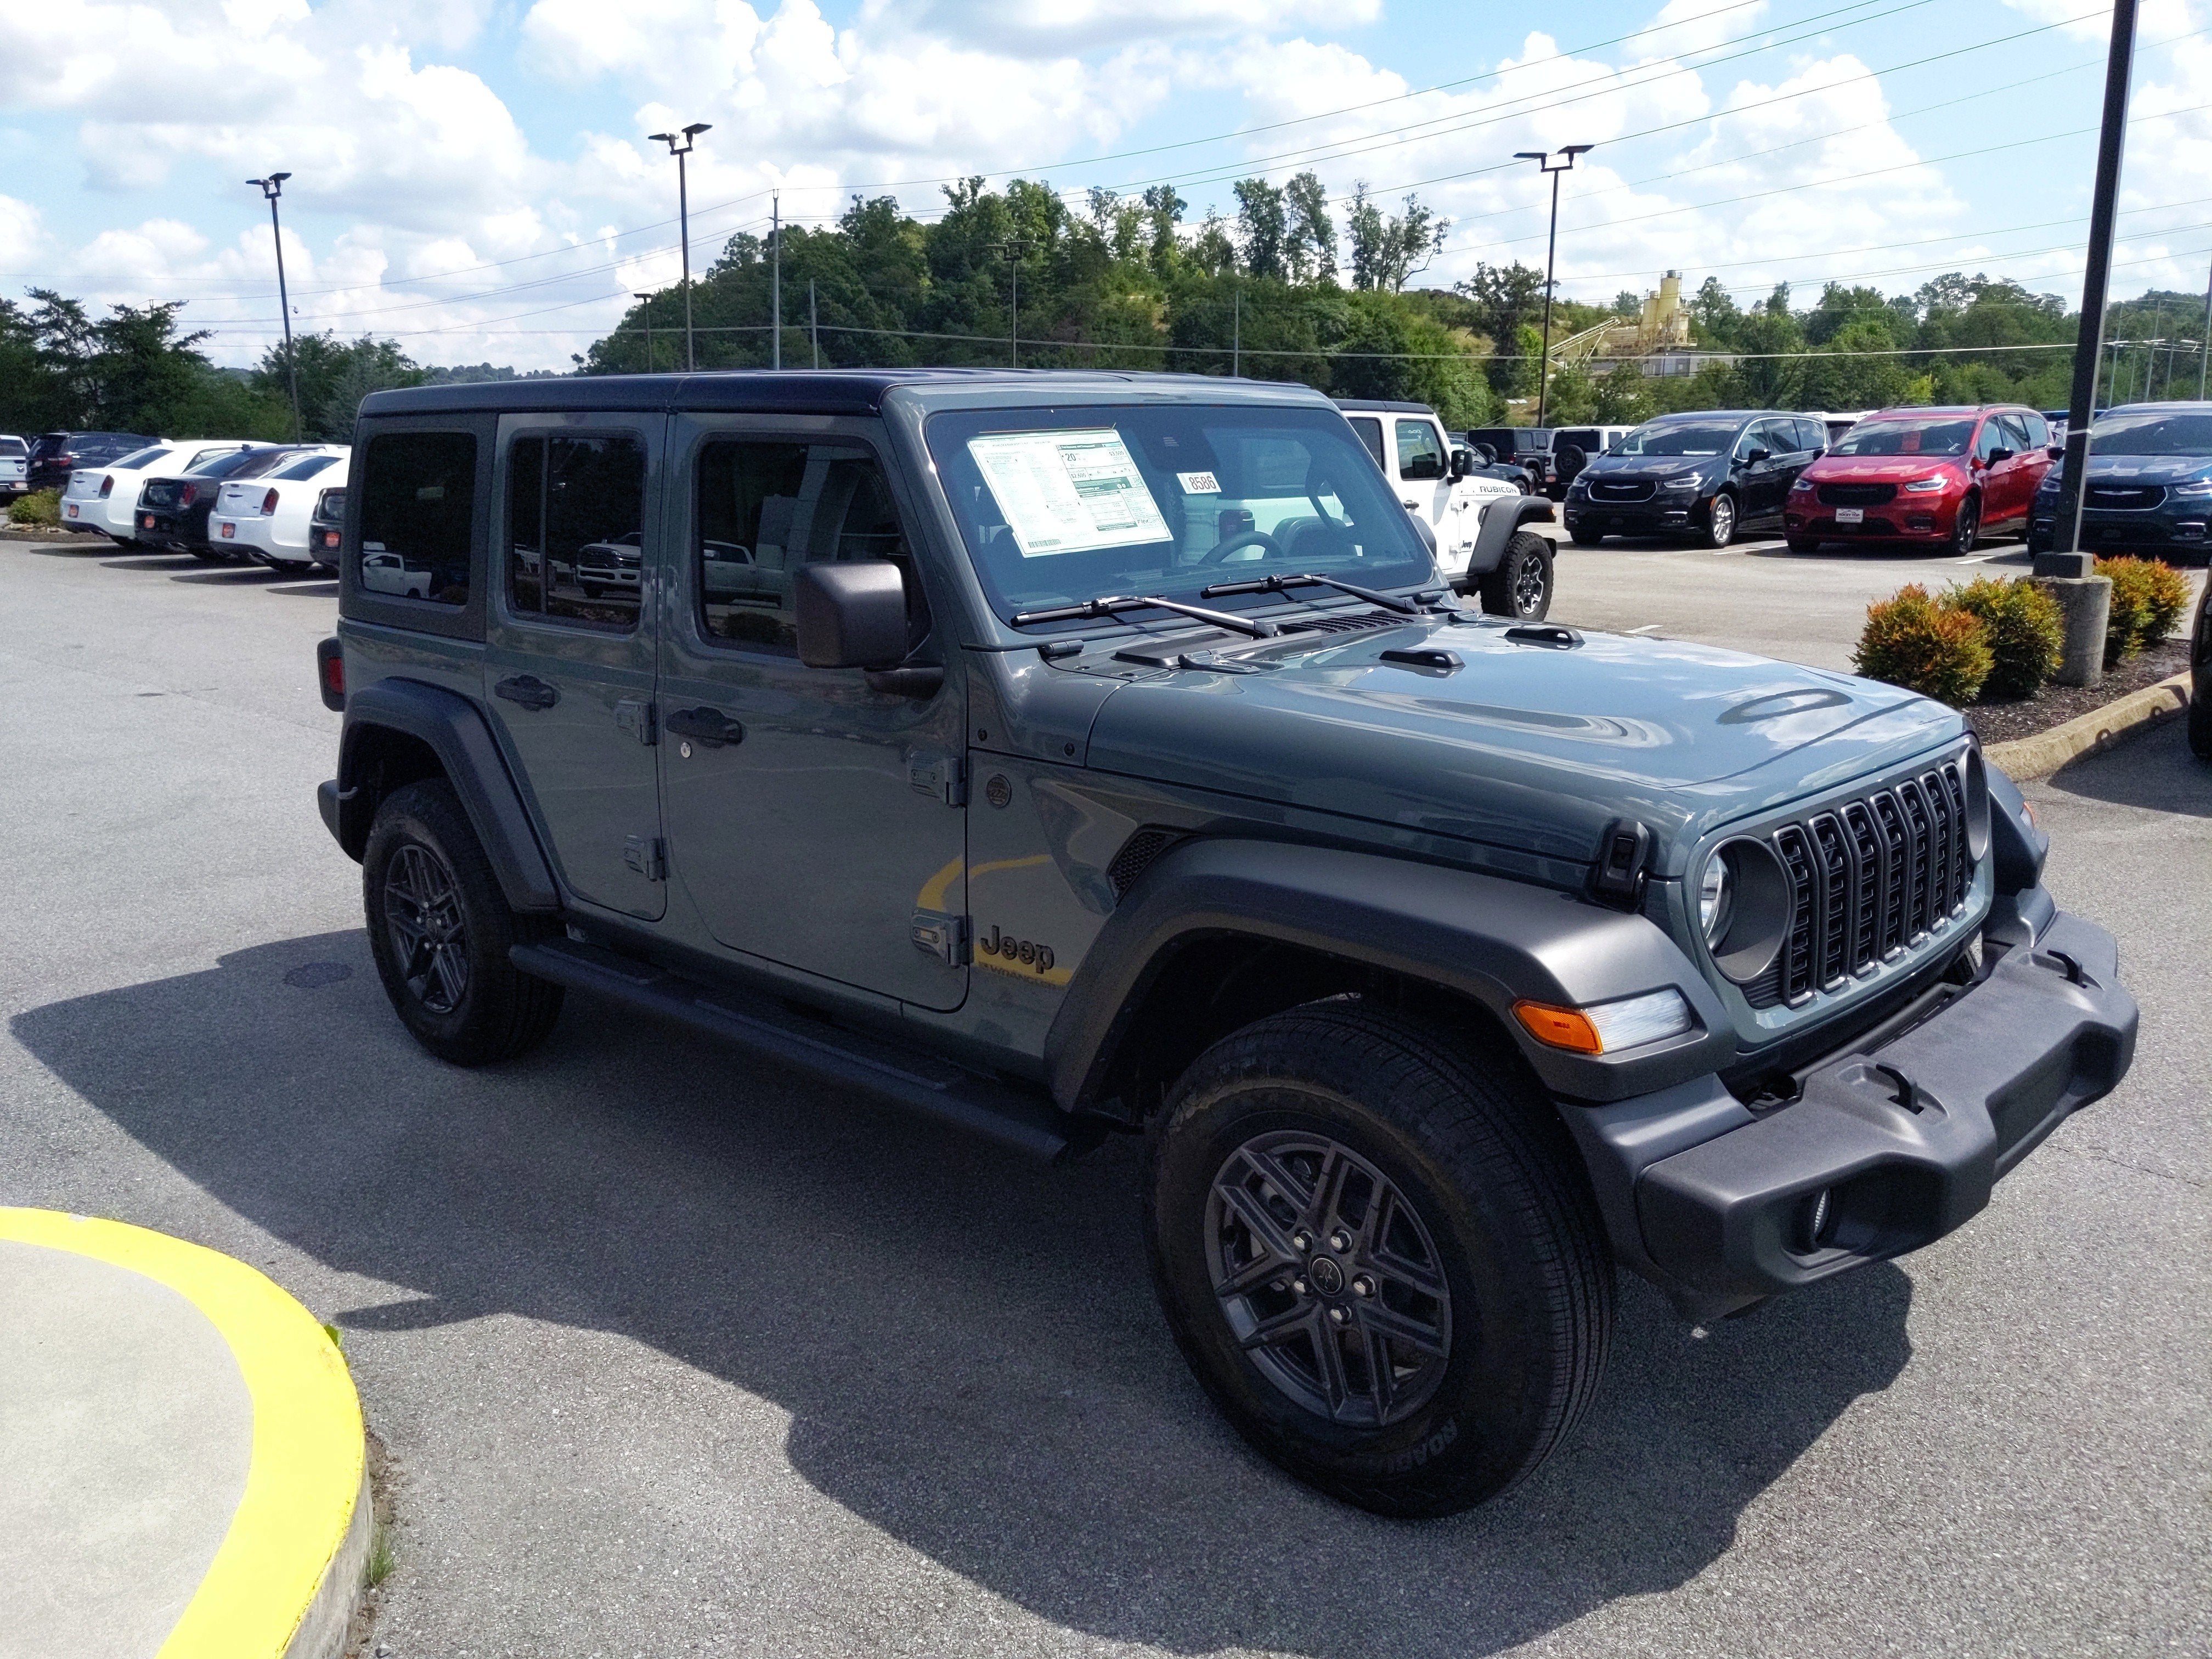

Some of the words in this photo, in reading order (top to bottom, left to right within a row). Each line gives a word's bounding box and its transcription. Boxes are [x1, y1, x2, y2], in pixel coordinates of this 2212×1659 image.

[1065, 453, 1076, 461] 20
[1188, 476, 1217, 490] 8586
[1479, 486, 1517, 494] RUBICON
[980, 925, 1054, 974] Jeep
